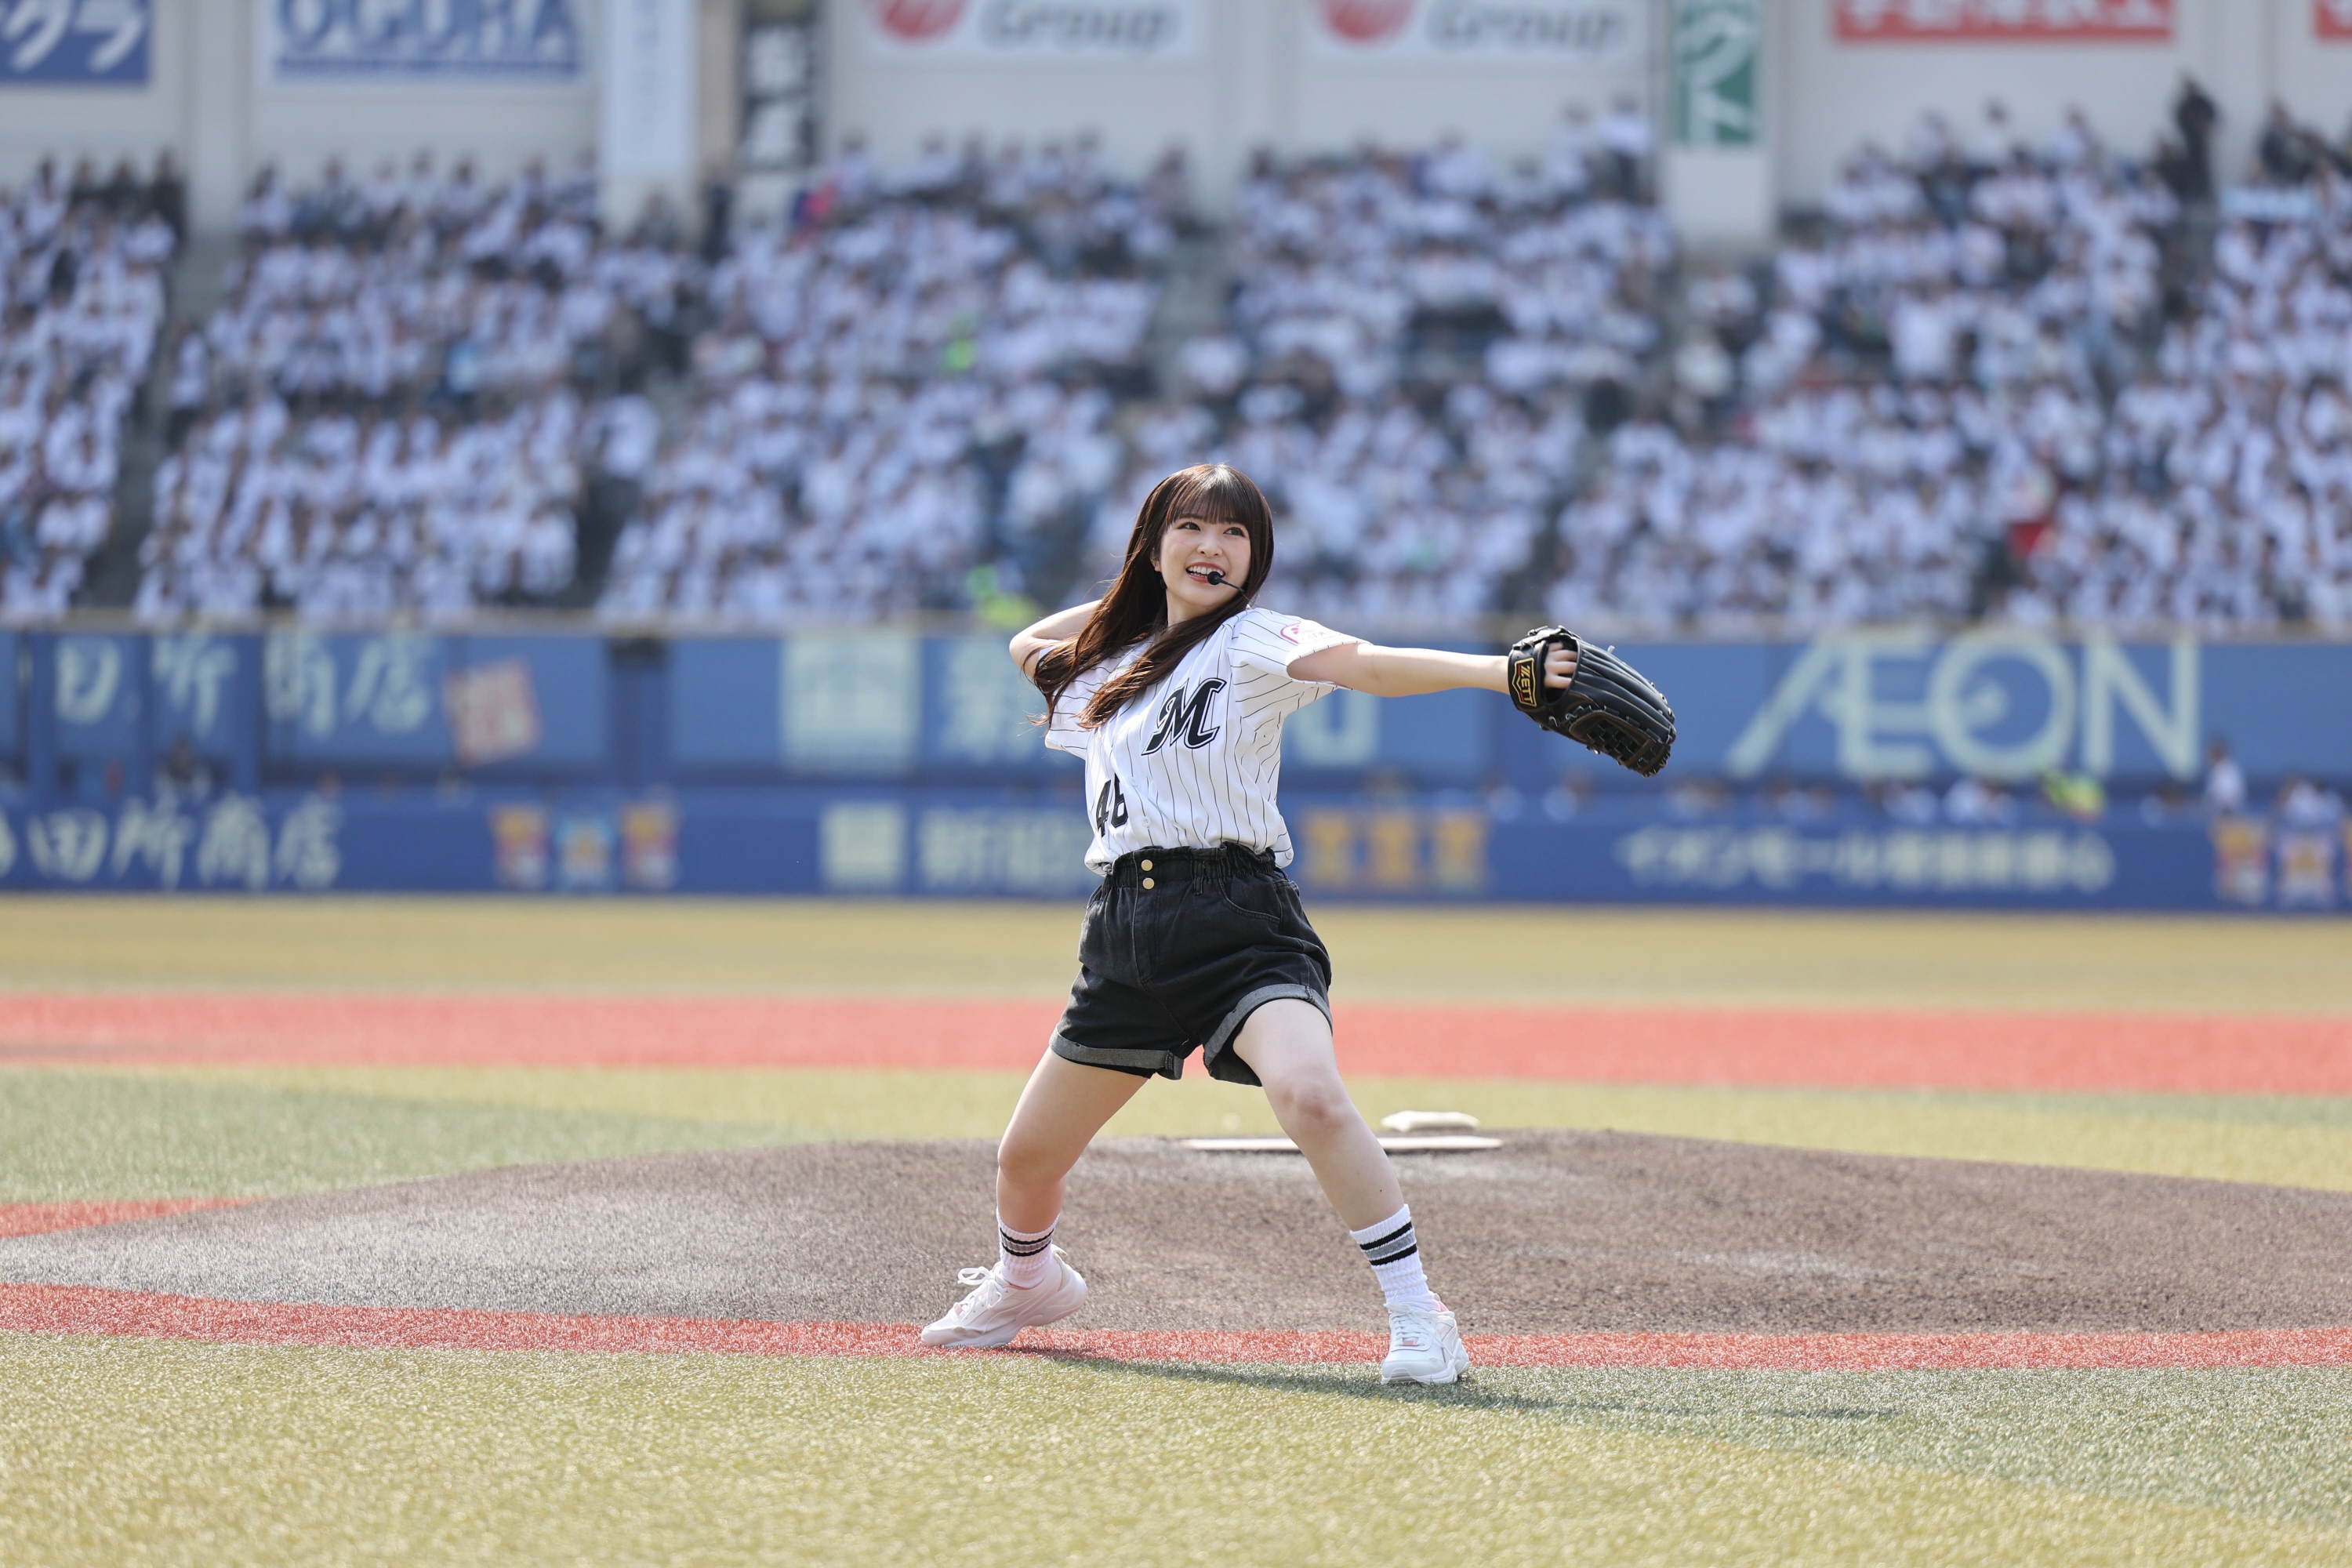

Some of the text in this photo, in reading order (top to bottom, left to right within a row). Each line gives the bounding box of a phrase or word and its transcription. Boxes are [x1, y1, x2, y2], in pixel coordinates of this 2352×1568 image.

[1142, 677, 1227, 756] M
[1519, 663, 1534, 705] ZETT
[0, 790, 345, 891] 田所商店
